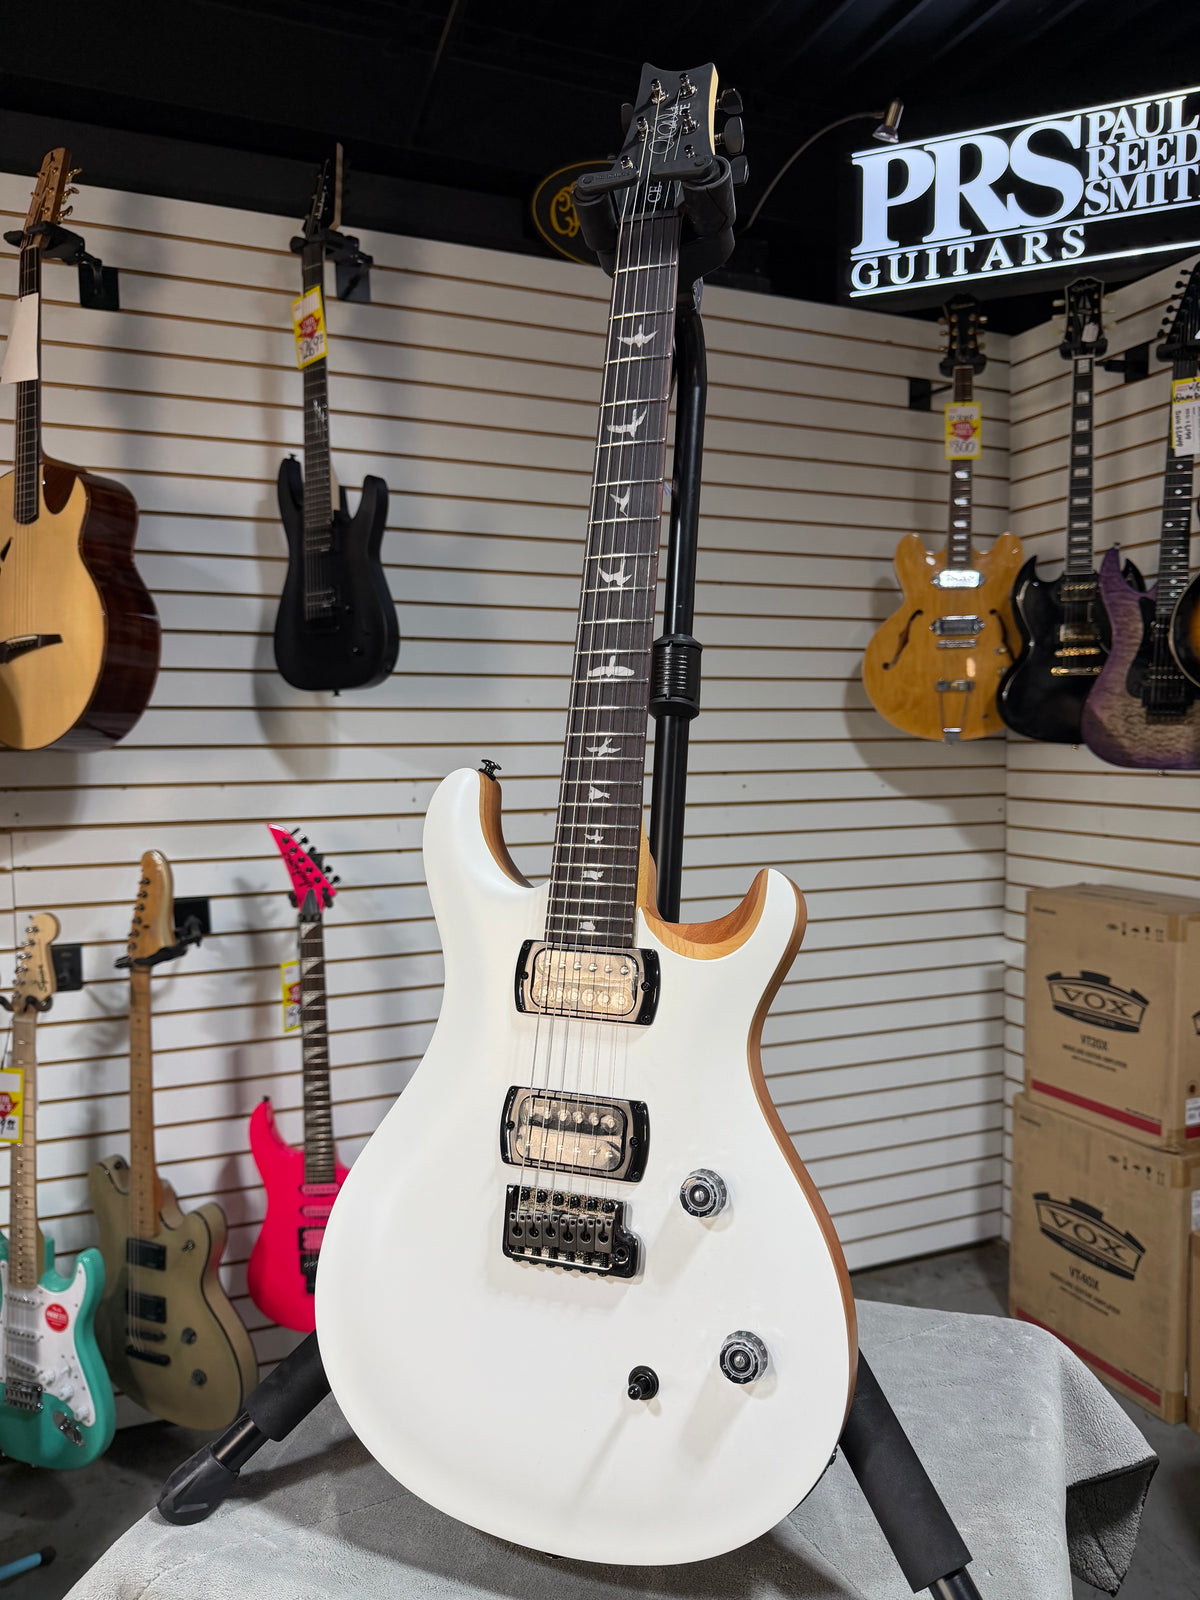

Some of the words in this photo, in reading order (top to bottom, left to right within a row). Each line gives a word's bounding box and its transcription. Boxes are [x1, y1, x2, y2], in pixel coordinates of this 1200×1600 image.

[1086, 95, 1200, 148] PAUL
[1085, 129, 1200, 182] REED
[852, 115, 1084, 254] PRS
[1084, 164, 1200, 217] SMIT
[851, 225, 1086, 291] GUITARS
[1058, 985, 1134, 1019] VOX
[1046, 1208, 1127, 1263] VOX
